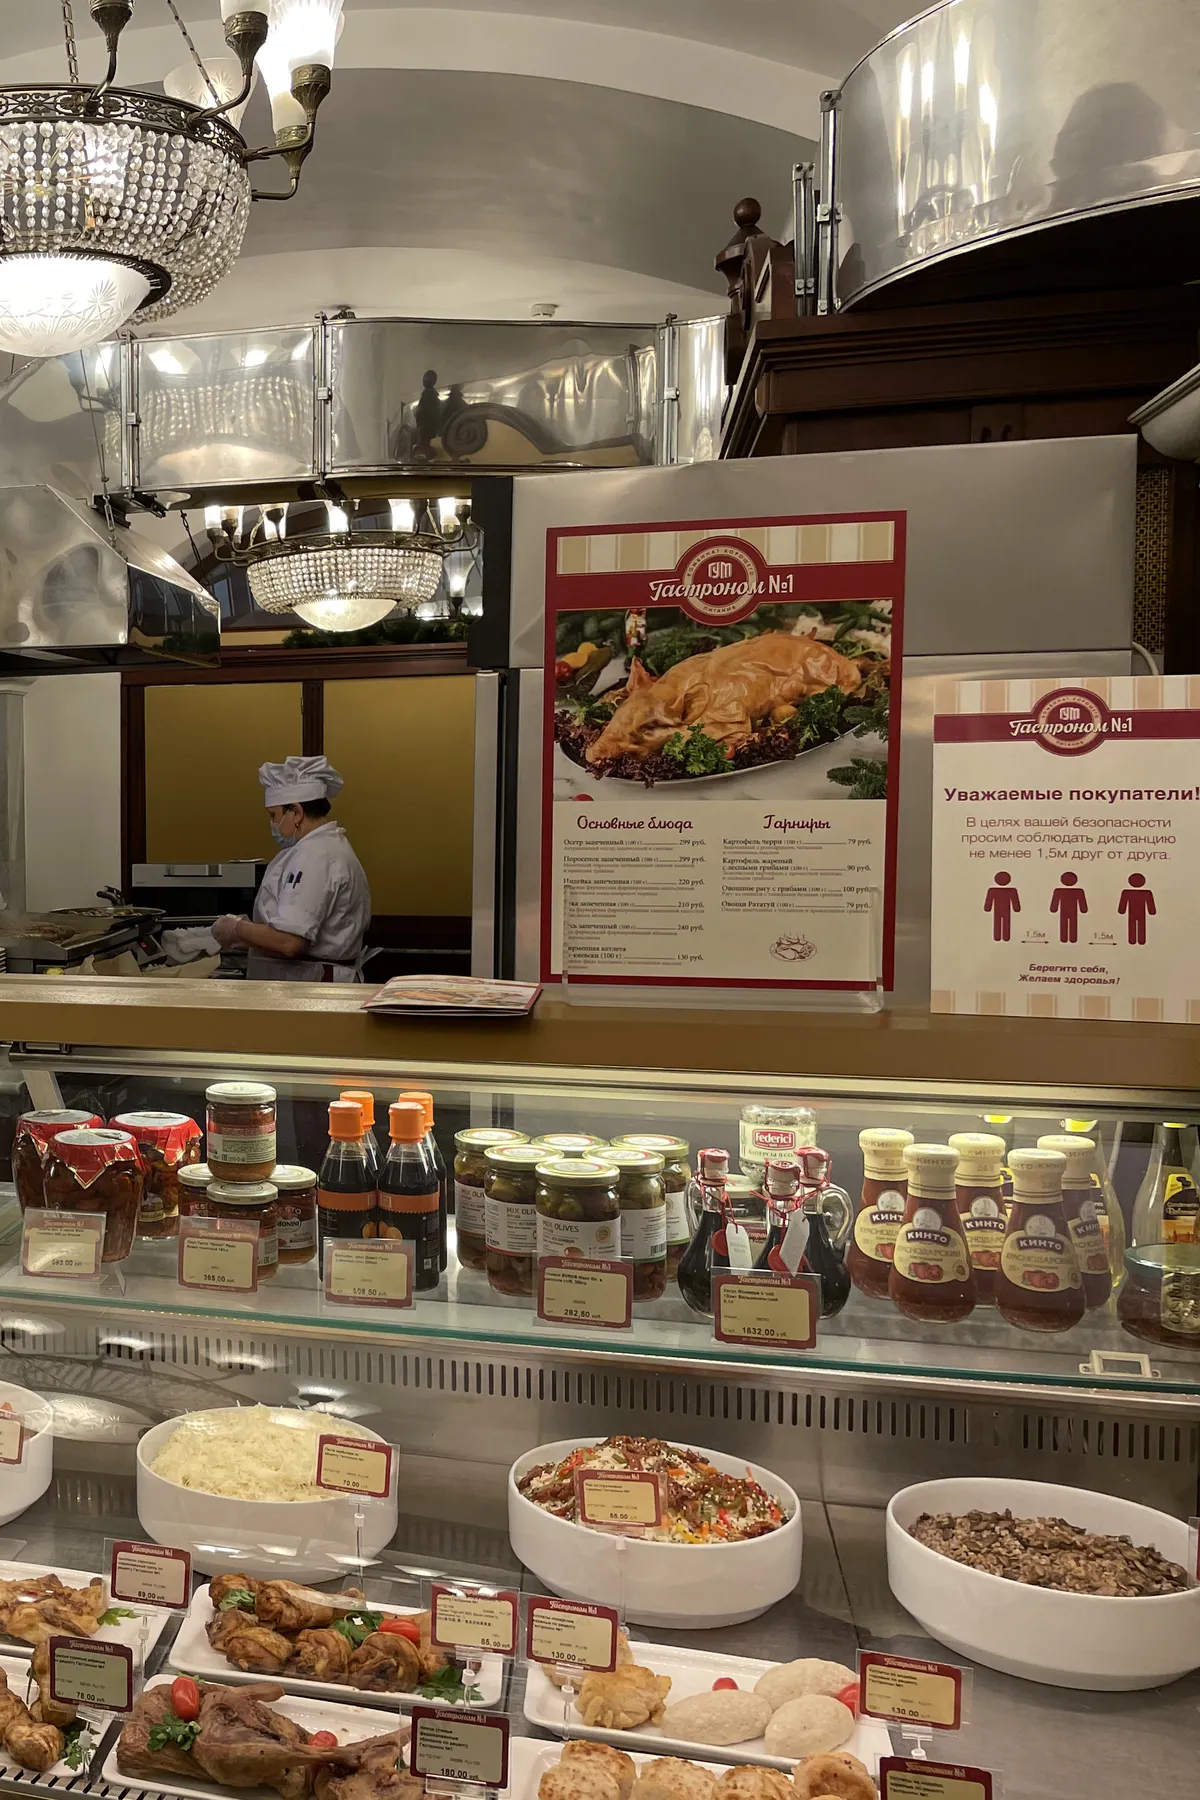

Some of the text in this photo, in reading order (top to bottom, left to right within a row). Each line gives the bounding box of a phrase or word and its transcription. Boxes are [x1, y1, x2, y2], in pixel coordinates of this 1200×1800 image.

[649, 574, 794, 601] Гастроном №1
[1009, 718, 1133, 737] Гастроном №1
[944, 786, 1200, 804] Уважаемые покупатели!
[577, 815, 693, 833] Основные блюда
[763, 814, 831, 833] Гарниры
[966, 817, 1172, 830] В целях вашей безопасности
[961, 832, 1176, 846] просим соблюдать дистанцию
[969, 848, 1171, 862] не менее 1,5м друг от друга.
[1025, 930, 1046, 939] 1,5м
[1093, 932, 1114, 940] 1,5м
[1029, 964, 1109, 974] Берегите себя,
[1018, 974, 1121, 986] Желаем здоровья!
[755, 1132, 792, 1143] Federici
[872, 1213, 904, 1222] КИНТ
[554, 1224, 579, 1232] OLIVES
[965, 1218, 1005, 1230] КИНТО
[907, 1230, 948, 1242] КИНТО
[1020, 1239, 1062, 1250] КИНТО
[550, 1601, 587, 1613] Гастроном
[69, 1640, 104, 1651] Гастроном
[435, 1709, 476, 1722] Гастроном
